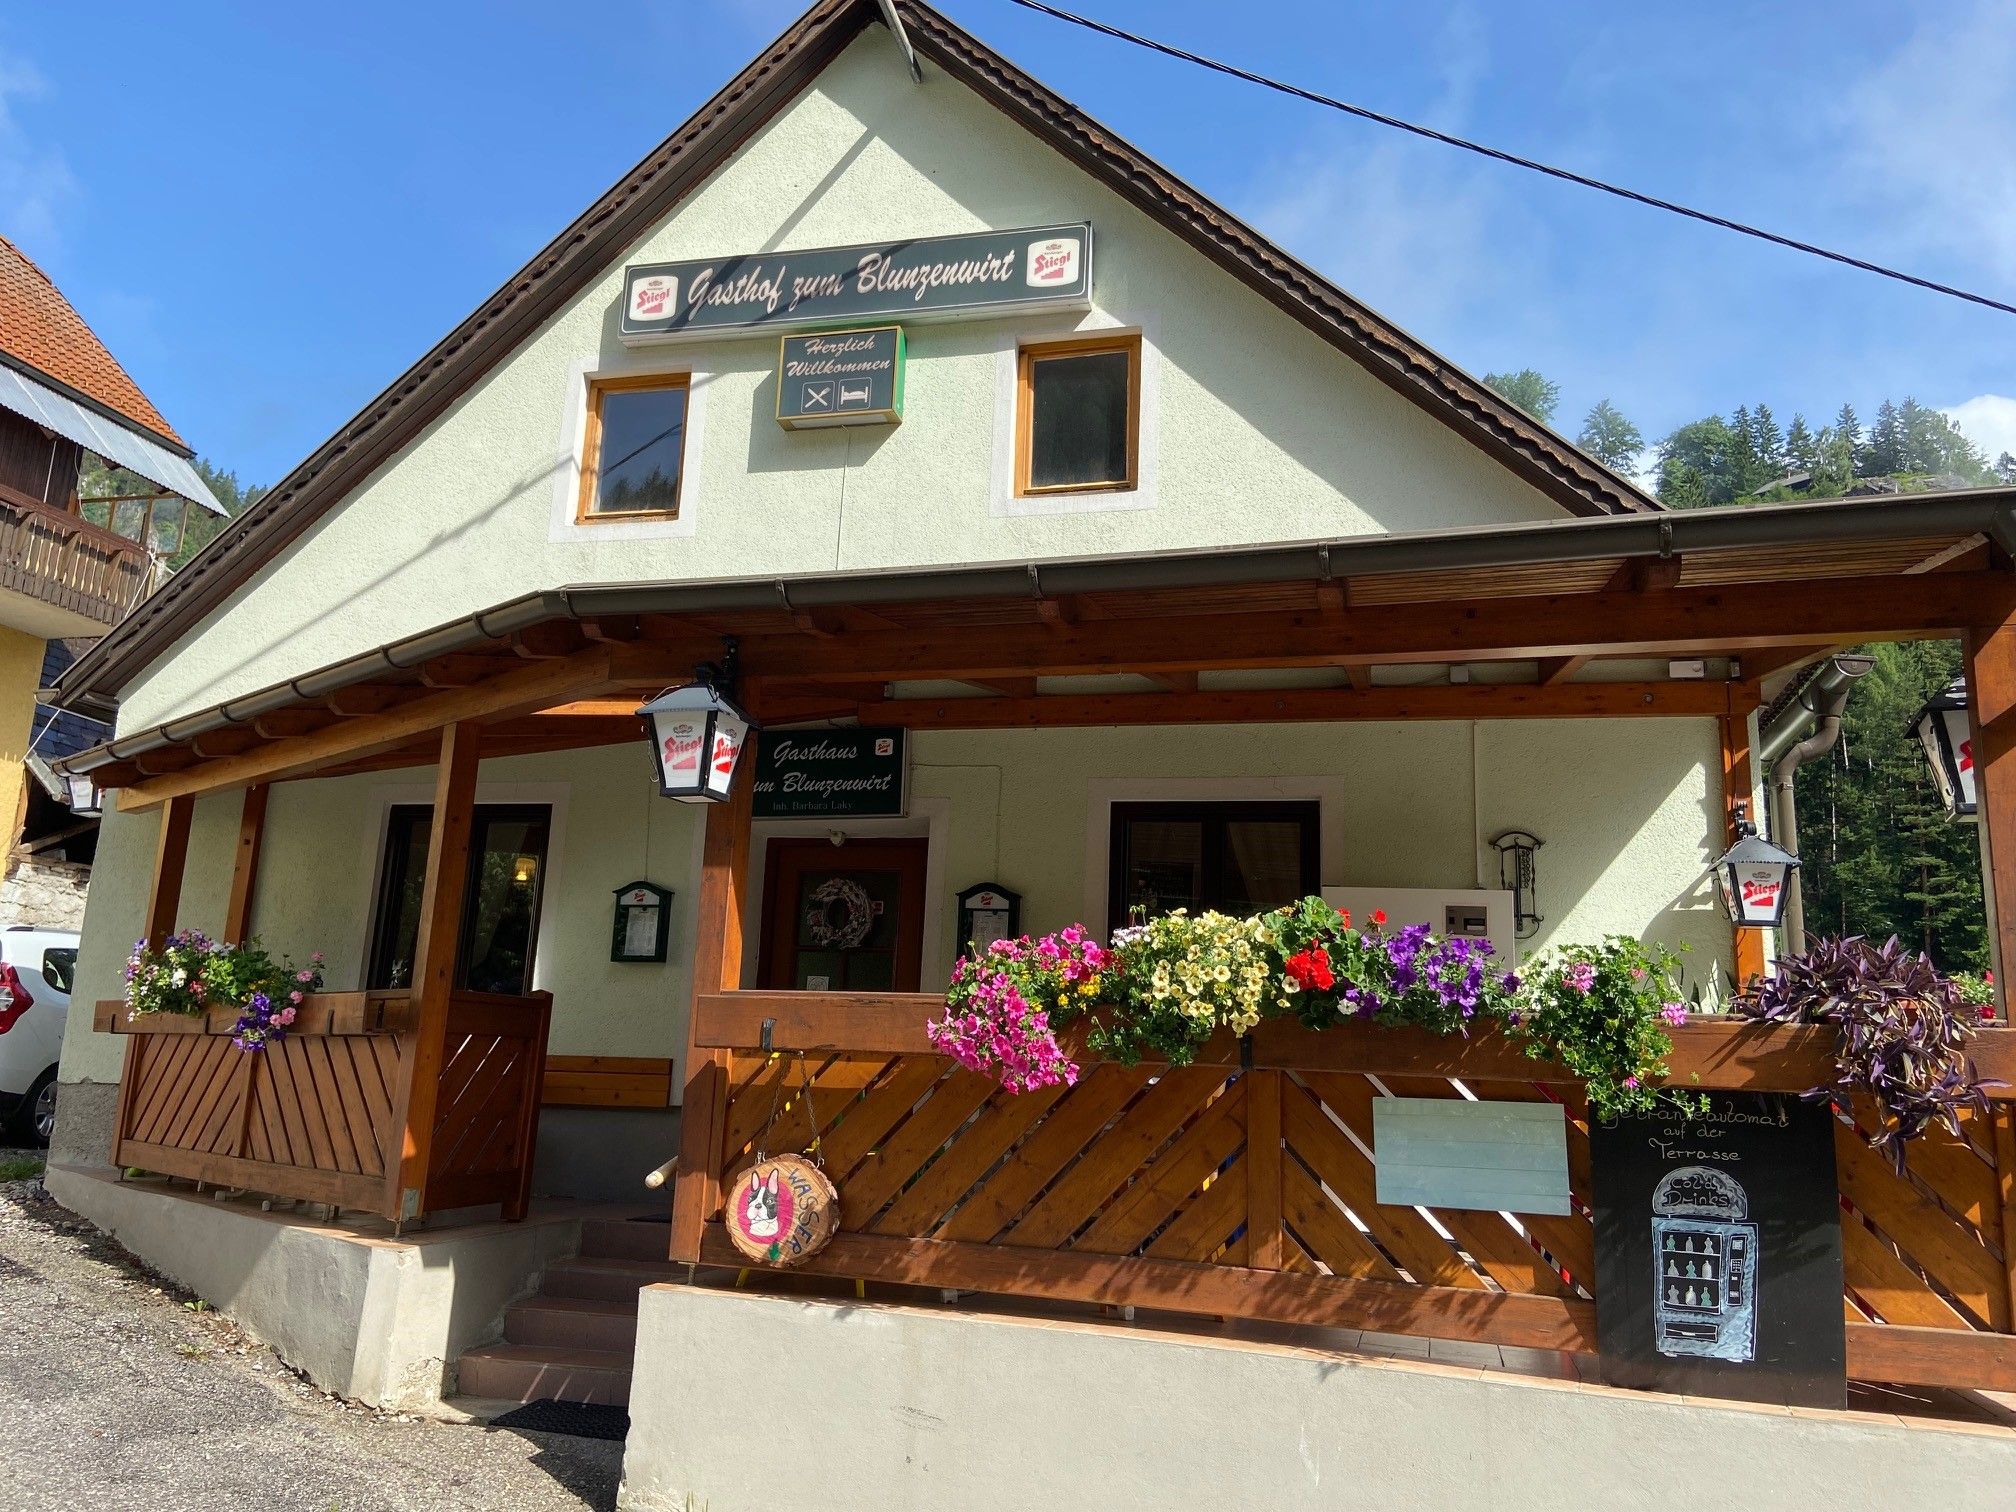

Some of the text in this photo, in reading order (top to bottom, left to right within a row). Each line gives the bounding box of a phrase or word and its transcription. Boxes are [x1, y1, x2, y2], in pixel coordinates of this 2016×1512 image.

[1034, 251, 1072, 275] Stiegl
[687, 249, 1016, 322] Gasthof zum Blunzenwirt
[636, 287, 671, 310] Stiegl
[804, 334, 876, 357] Herzlich
[786, 359, 891, 377] Willkommen
[773, 739, 859, 768] Gasthaus
[753, 772, 892, 798] um Blunzenwirt
[1601, 1101, 1789, 1130] eträneautomat
[1664, 1122, 1727, 1139] auf der
[1649, 1138, 1742, 1161] Terrasse
[1671, 1174, 1716, 1190] Cold
[1662, 1190, 1728, 1206] Drinks
[788, 1168, 820, 1255] WASSER
